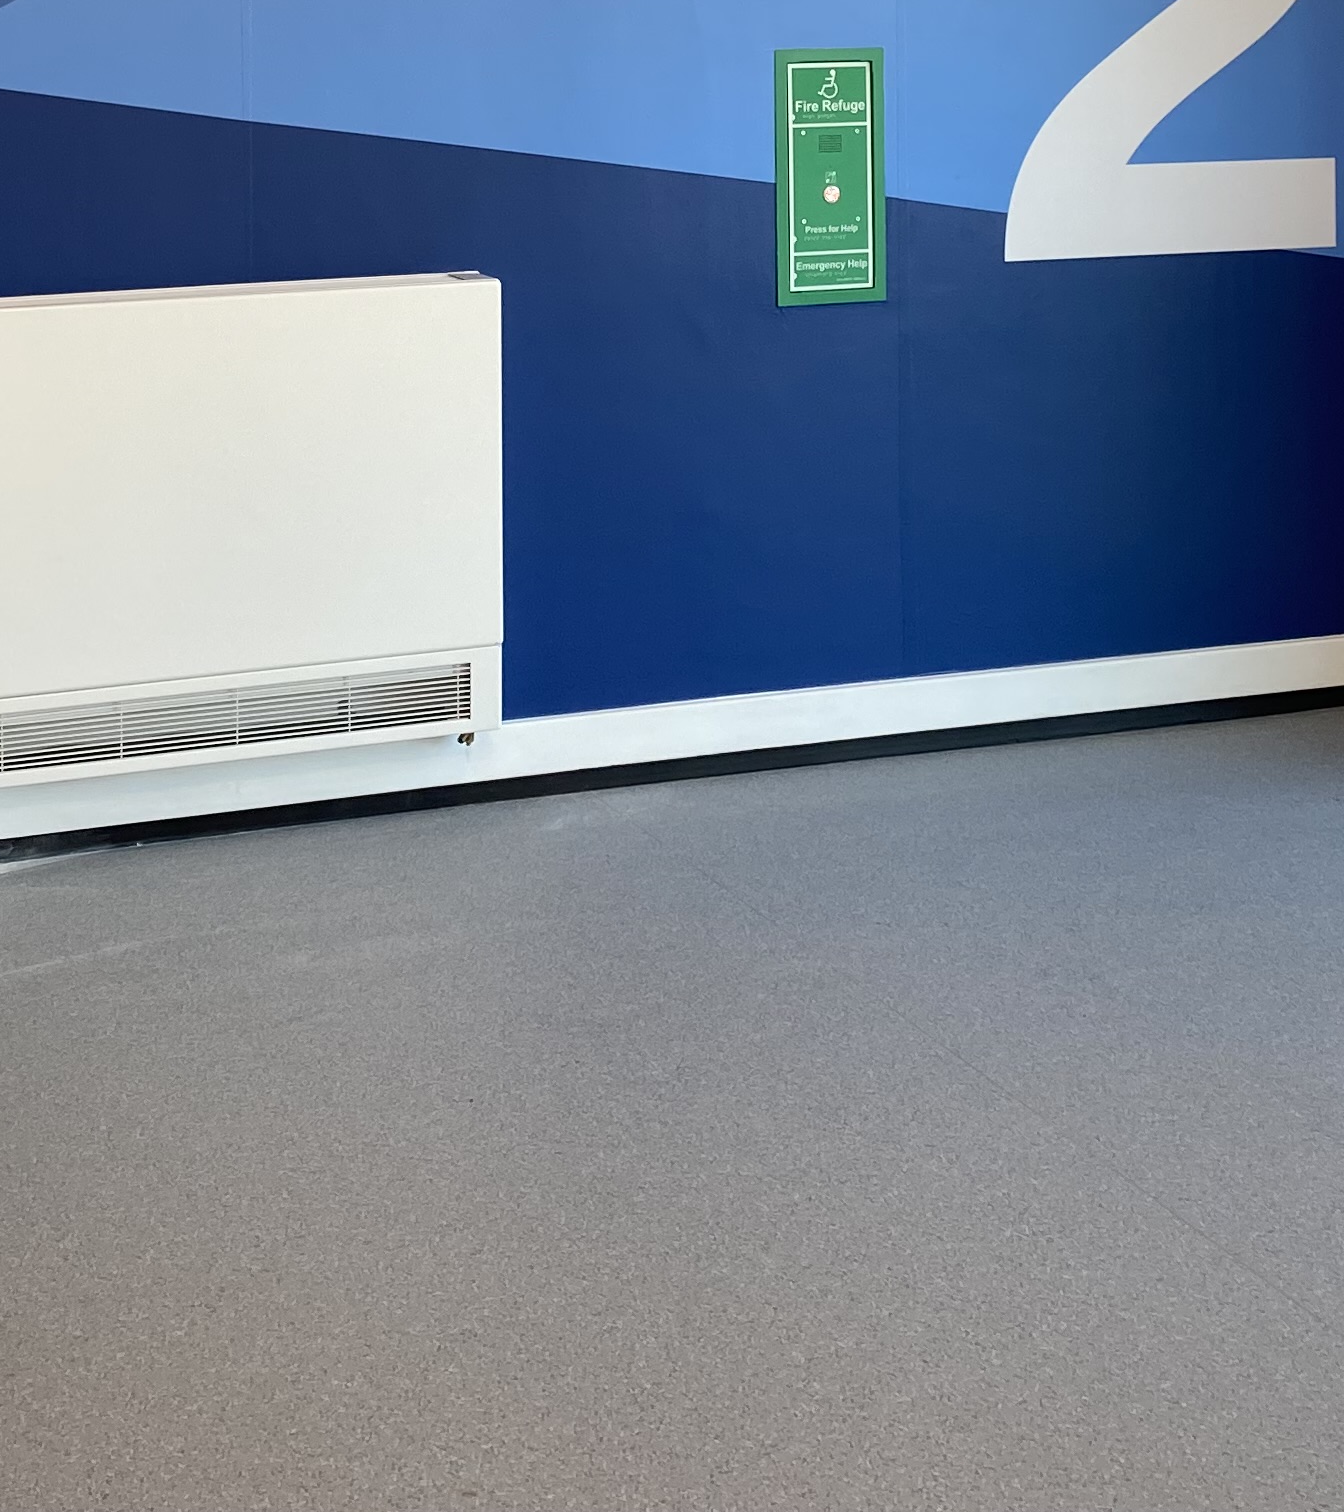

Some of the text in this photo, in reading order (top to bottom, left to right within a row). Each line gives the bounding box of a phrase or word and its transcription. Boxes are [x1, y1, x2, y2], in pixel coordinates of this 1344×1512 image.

[795, 99, 866, 114] Fire Refuge
[804, 224, 859, 234] Press for Help
[795, 259, 868, 272] Emergency Help
